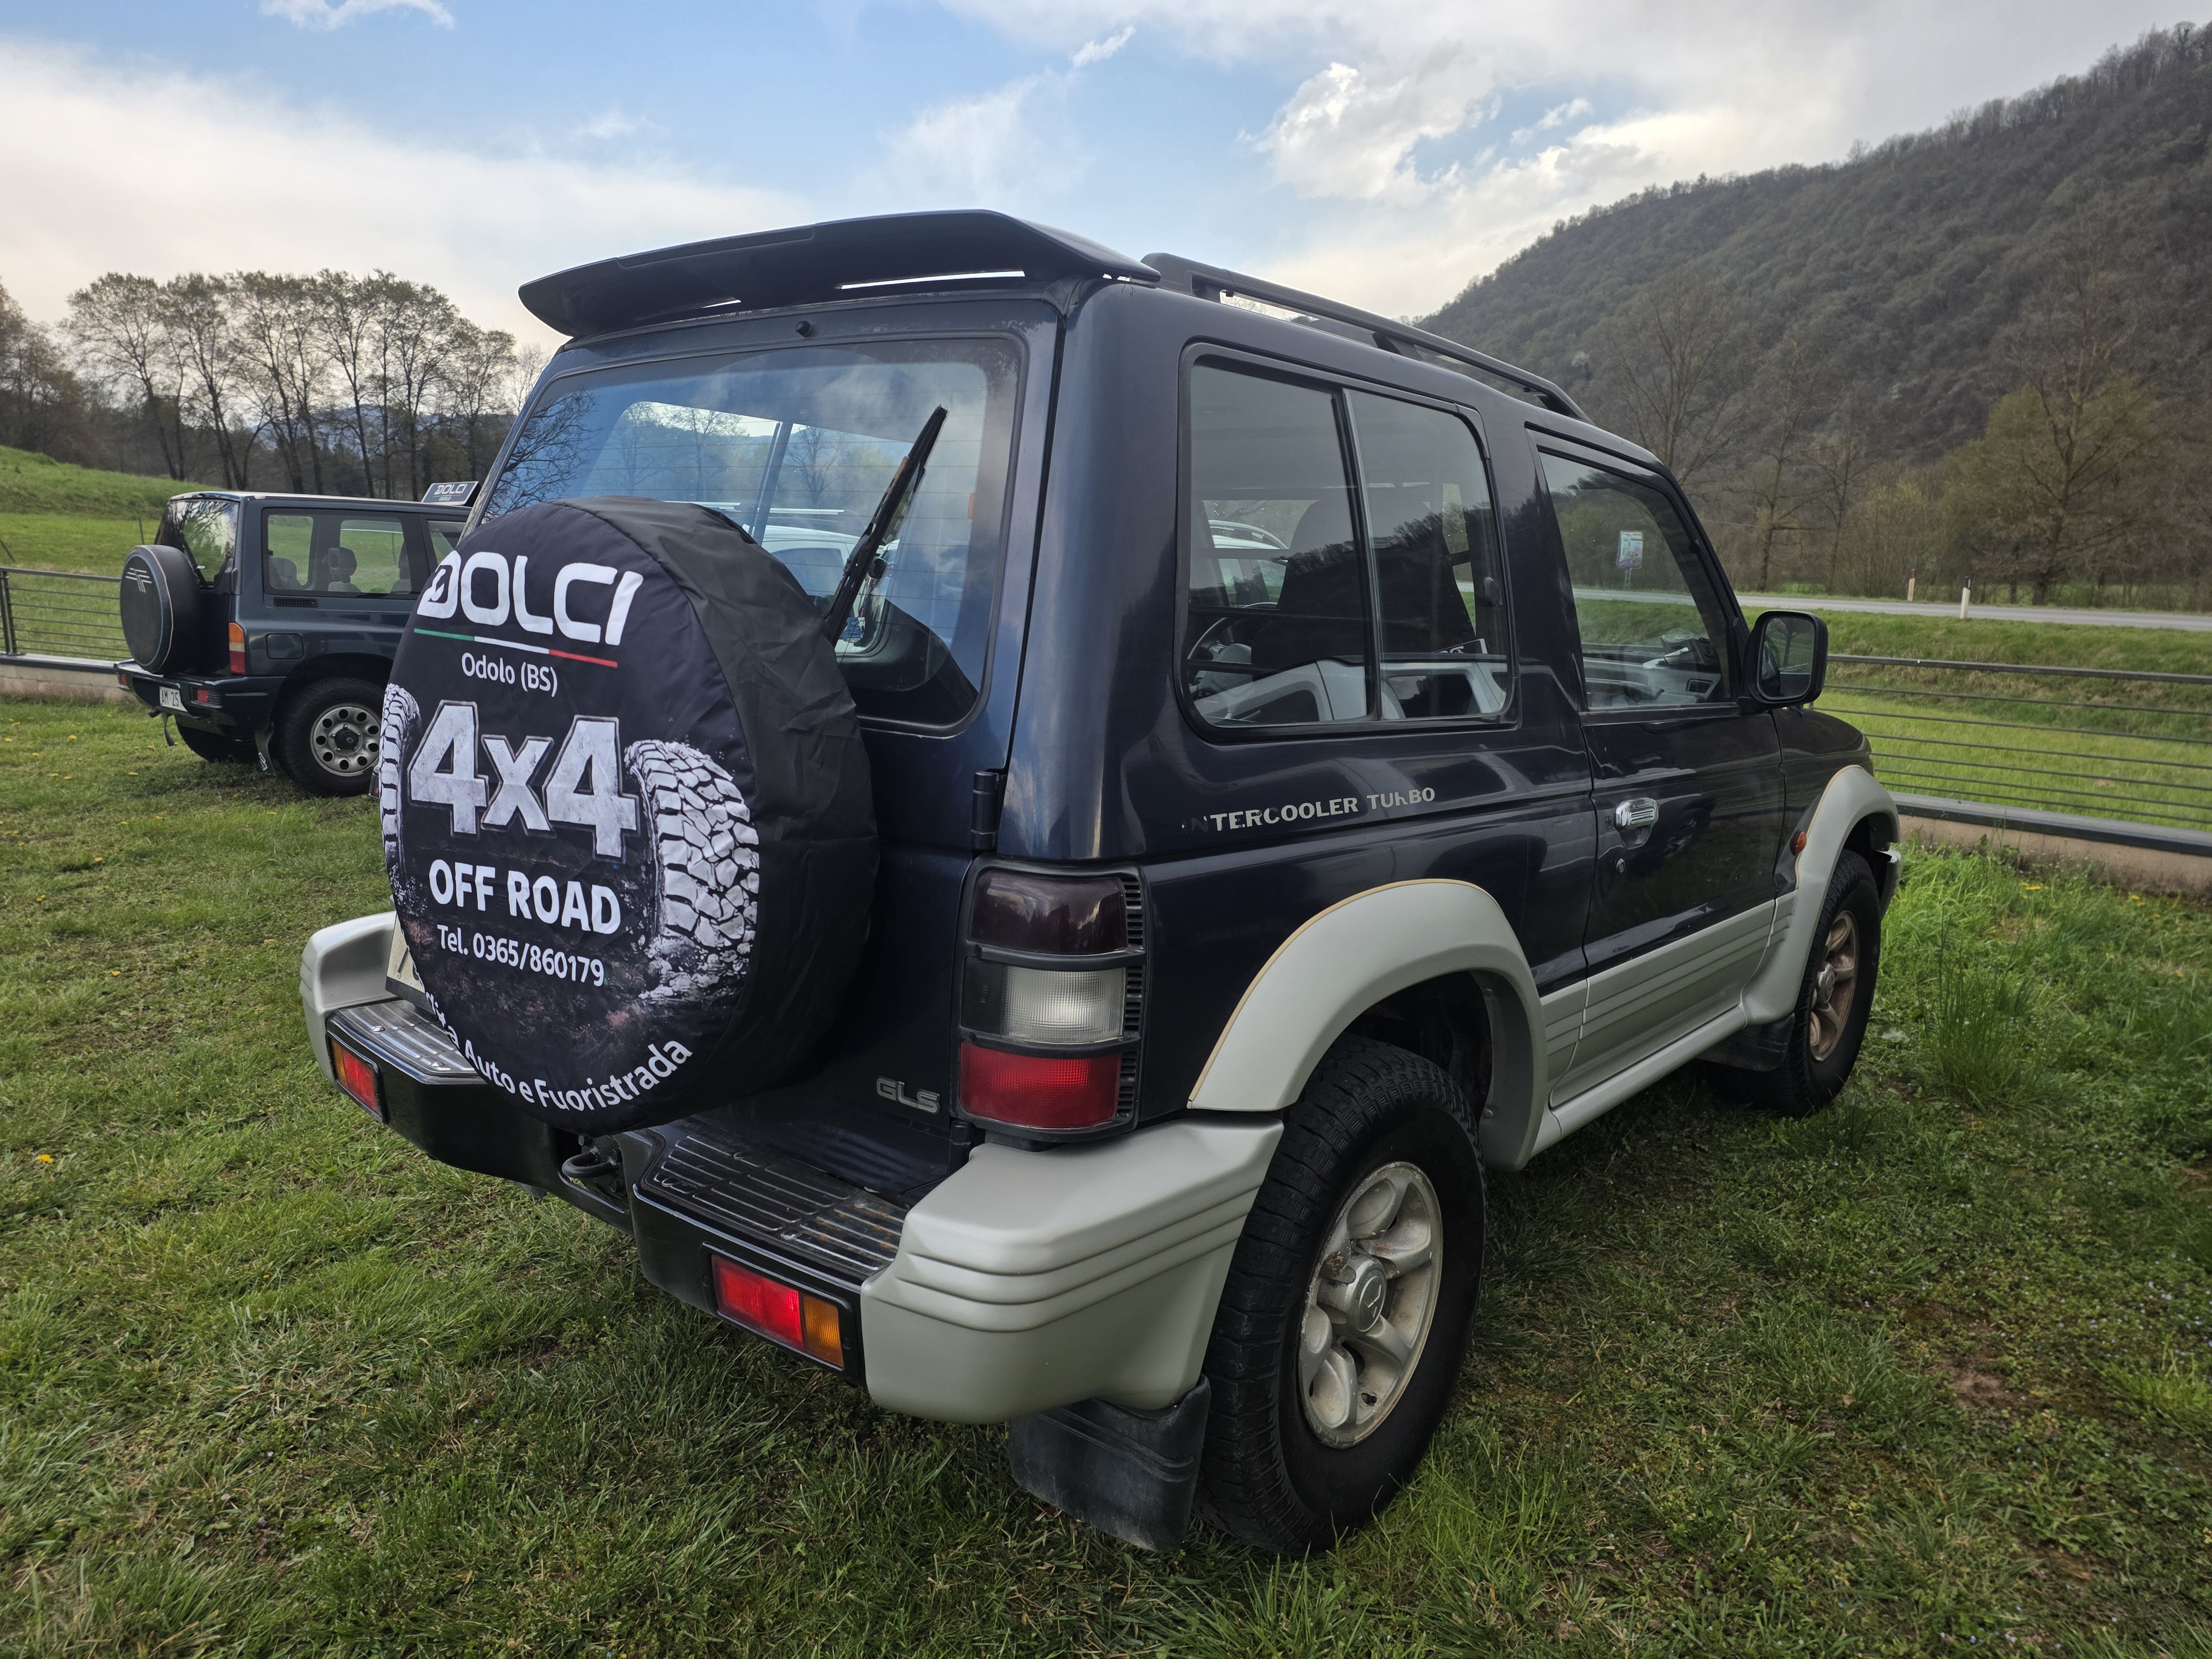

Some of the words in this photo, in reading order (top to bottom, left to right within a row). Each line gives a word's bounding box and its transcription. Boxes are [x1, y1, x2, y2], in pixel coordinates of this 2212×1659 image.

[417, 550, 644, 646] DOLCI
[461, 652, 515, 684] Odolo
[521, 661, 558, 697] (BS)
[407, 699, 641, 864] 4x4
[429, 859, 496, 911] OFF
[507, 870, 621, 935] ROAD
[437, 924, 468, 956] Tel.
[473, 932, 605, 987] 0365/860179
[461, 1039, 515, 1094] Auto
[519, 1081, 535, 1104] e
[534, 1040, 693, 1112] Fuoristrada
[877, 1078, 940, 1114] GLS
